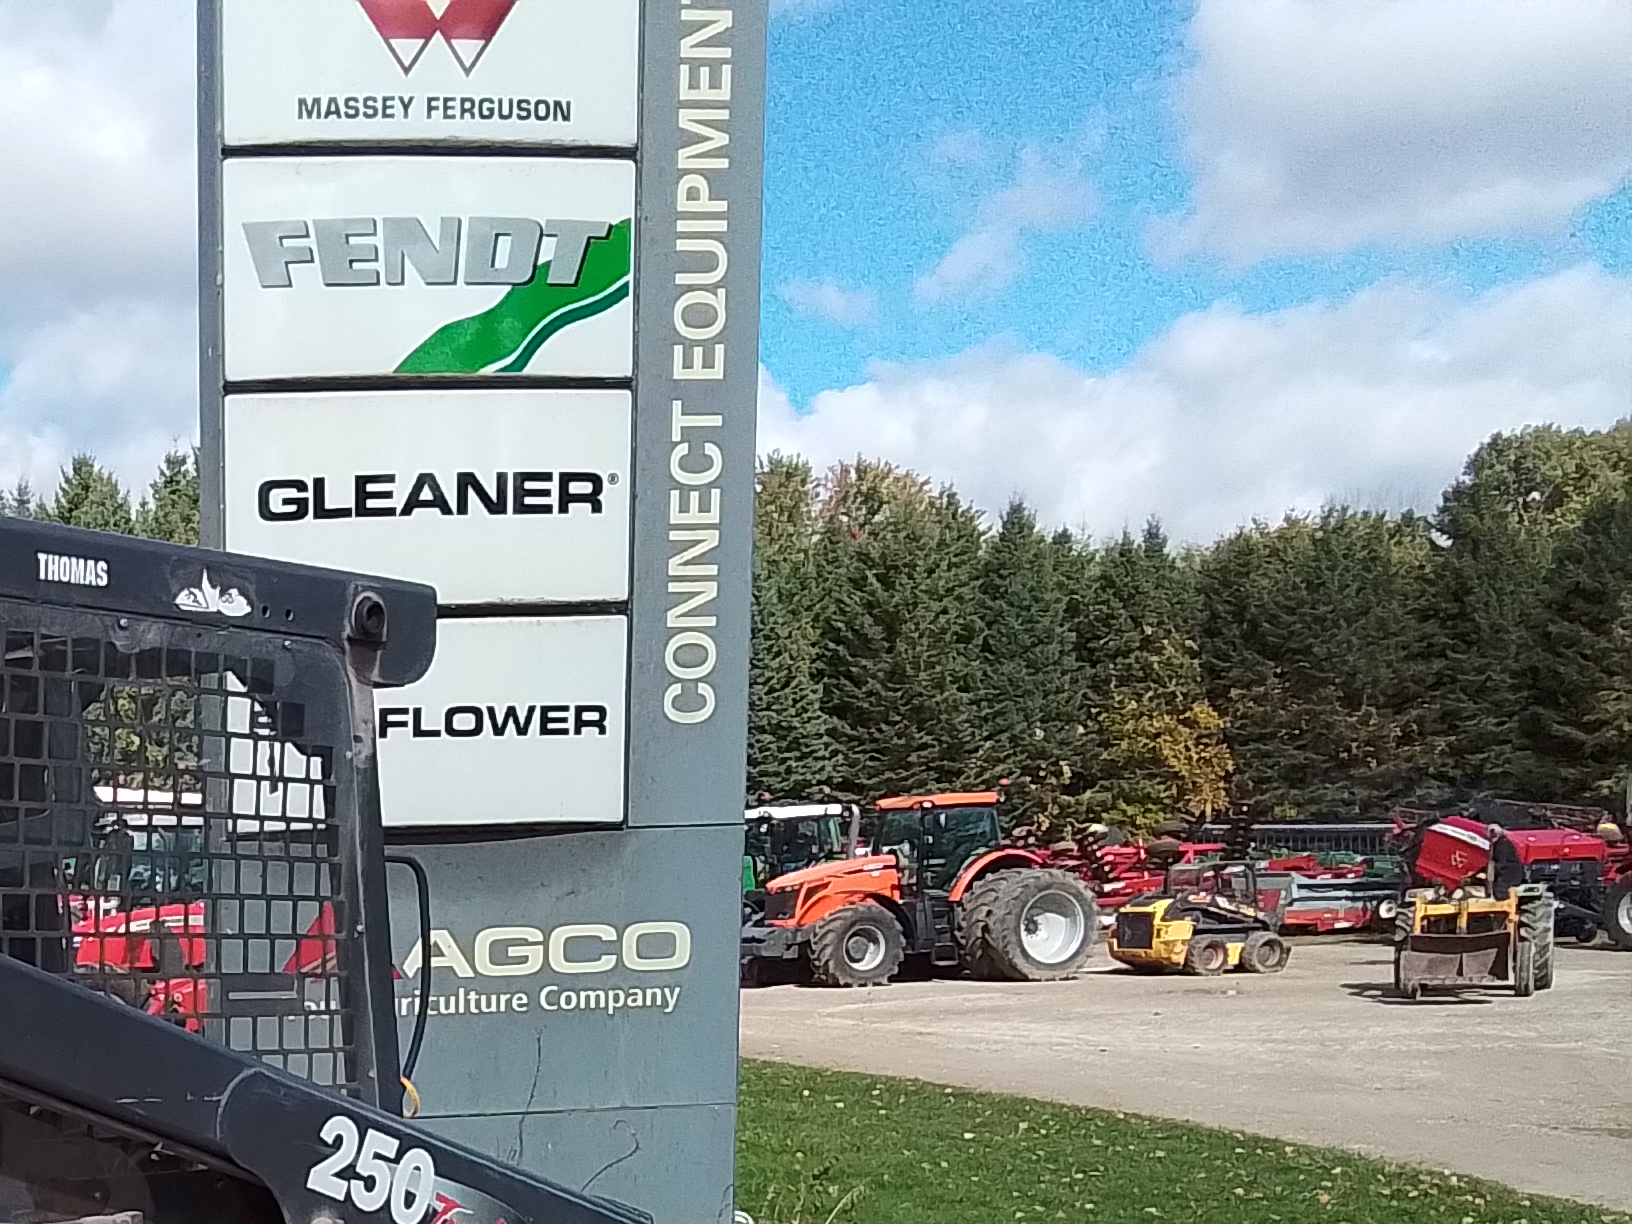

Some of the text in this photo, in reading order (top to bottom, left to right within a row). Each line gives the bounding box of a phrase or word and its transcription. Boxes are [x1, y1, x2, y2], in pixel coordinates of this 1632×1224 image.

[297, 95, 572, 123] MASSEY FERGUSON
[241, 216, 612, 288] FENDT
[664, 0, 733, 725] CONNECT EQUIPMEN
[37, 552, 109, 587] THOMAS
[378, 704, 608, 738] FLOWER
[402, 921, 693, 978] AGCO
[395, 985, 681, 1017] riculture Company
